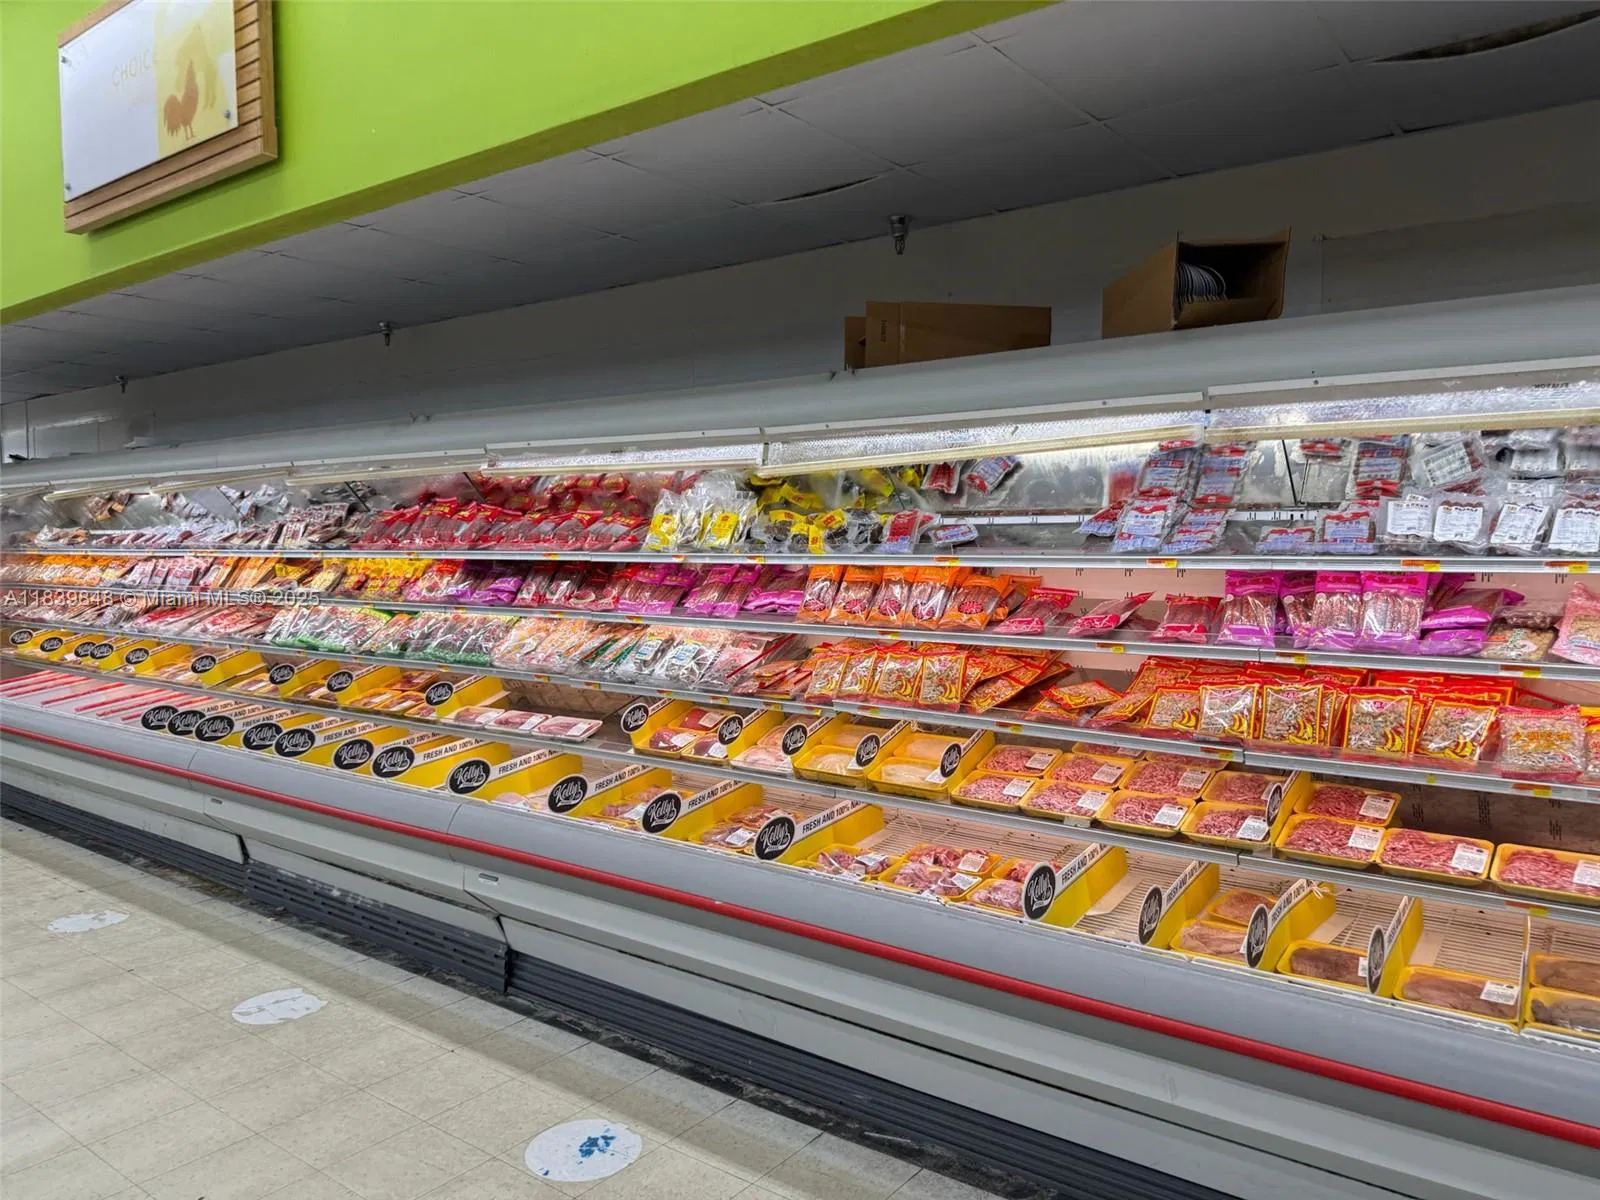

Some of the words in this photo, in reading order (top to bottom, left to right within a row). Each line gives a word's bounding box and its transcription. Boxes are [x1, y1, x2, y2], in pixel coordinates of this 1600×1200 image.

[200, 720, 231, 738] Kelly's
[324, 733, 342, 742] FRESH
[344, 728, 357, 736] AND
[280, 732, 312, 752] Kelly's
[402, 738, 415, 746] AND
[423, 748, 443, 760] FRESH
[444, 743, 458, 754] AND
[459, 739, 473, 750] 100%
[339, 745, 370, 765] Kelly's
[377, 750, 411, 773] Kelly's
[498, 761, 518, 775] FRESH
[519, 757, 532, 768] AND
[533, 751, 547, 763] 100%
[454, 764, 486, 788] Kelly's
[595, 778, 614, 792] FRESH
[614, 771, 627, 784] AND
[627, 766, 641, 778] 100%
[552, 780, 584, 807] Kelly's
[688, 795, 706, 810] FRESH
[706, 788, 719, 800] AND
[720, 779, 733, 793] 100%
[648, 797, 676, 827] Kelly's
[802, 818, 821, 834] FRESH
[822, 810, 836, 824] AND
[836, 803, 850, 817] 100%
[760, 821, 791, 853] Kelly's
[1061, 869, 1075, 886] FRESH
[1075, 856, 1088, 873] AND
[1027, 872, 1053, 911] Kelly's
[1178, 876, 1188, 892] AND
